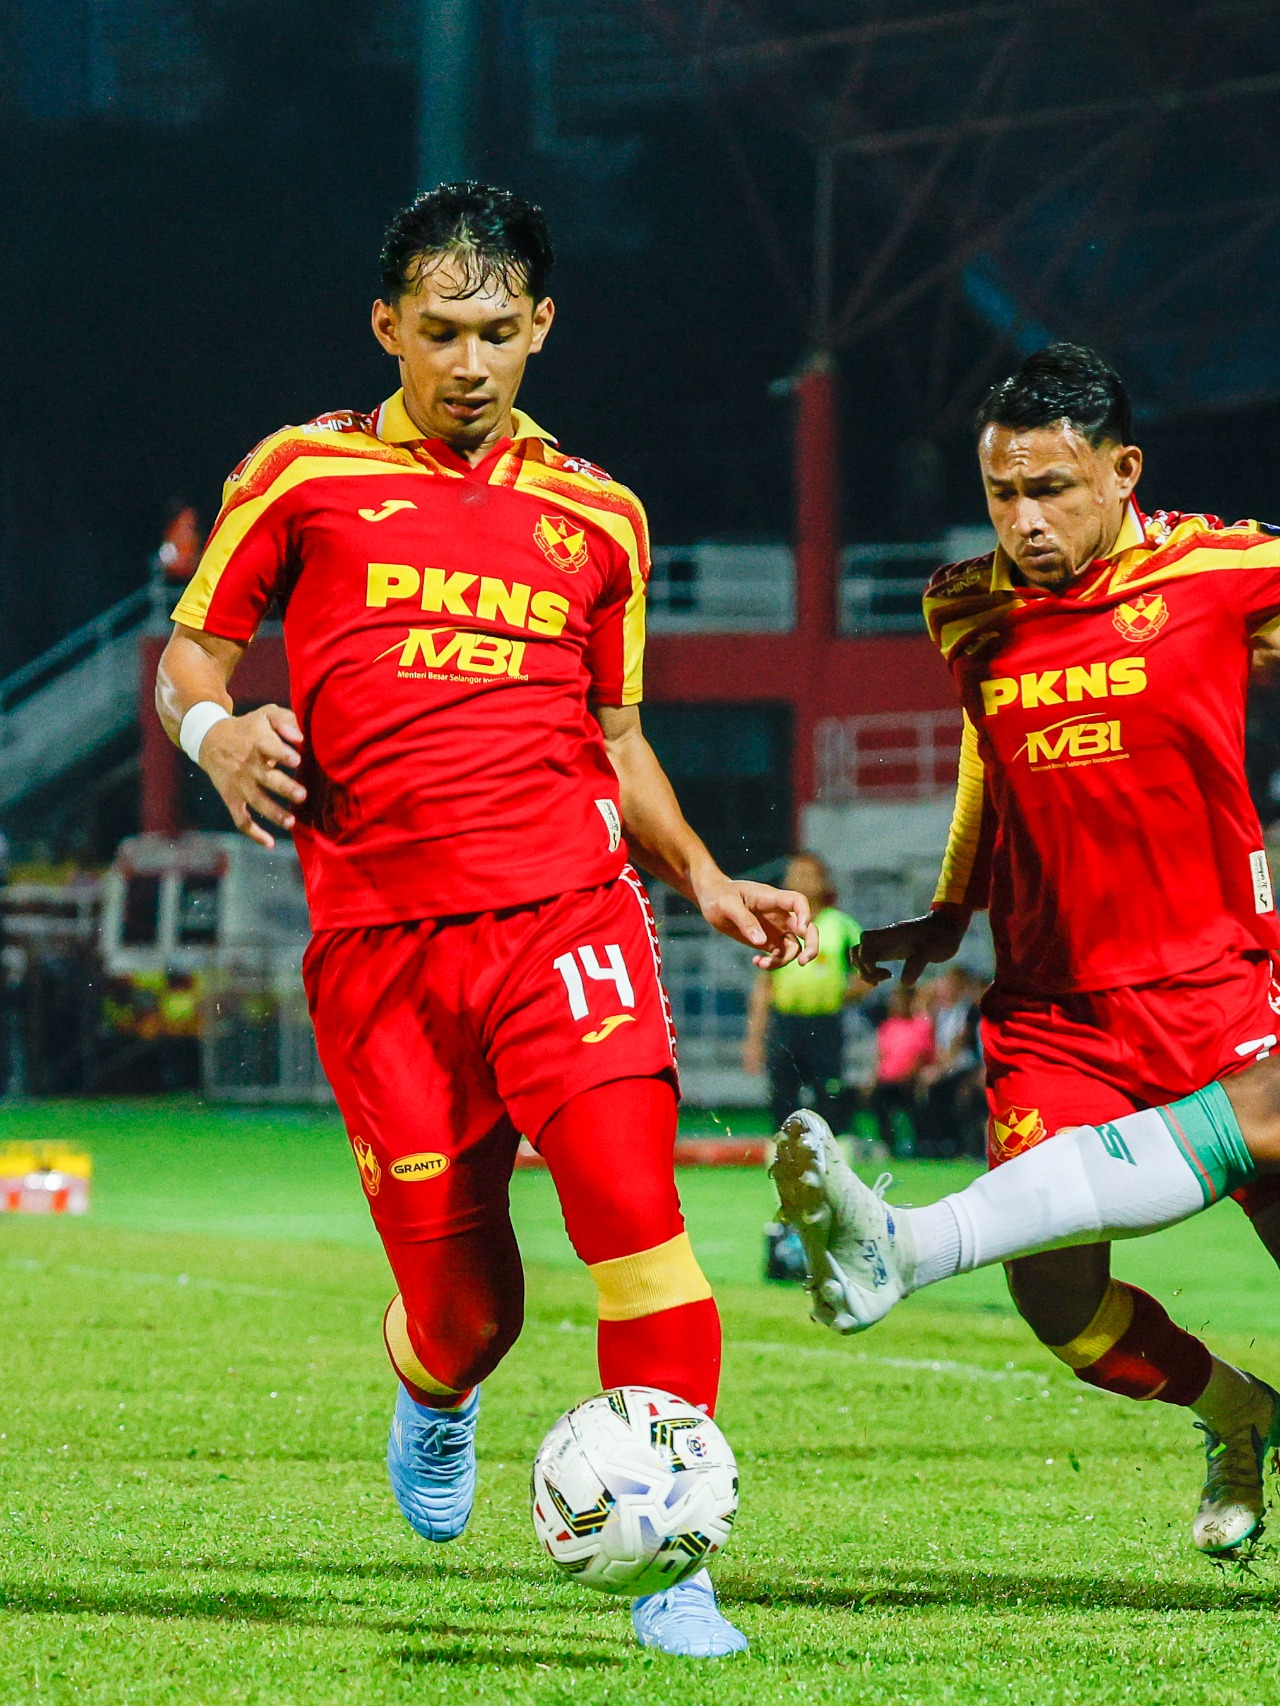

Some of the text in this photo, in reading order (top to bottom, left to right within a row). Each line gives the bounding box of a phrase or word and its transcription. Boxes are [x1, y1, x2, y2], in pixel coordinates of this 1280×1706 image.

[365, 562, 570, 636] PKNS
[398, 628, 526, 677] MBI
[397, 670, 426, 679] Menteri
[428, 672, 448, 681] Besar
[450, 673, 482, 685] Selangor
[980, 657, 1147, 716] PKNS
[1025, 720, 1124, 764] MBI
[553, 944, 635, 1021] 14
[394, 1159, 442, 1174] GRANTT
